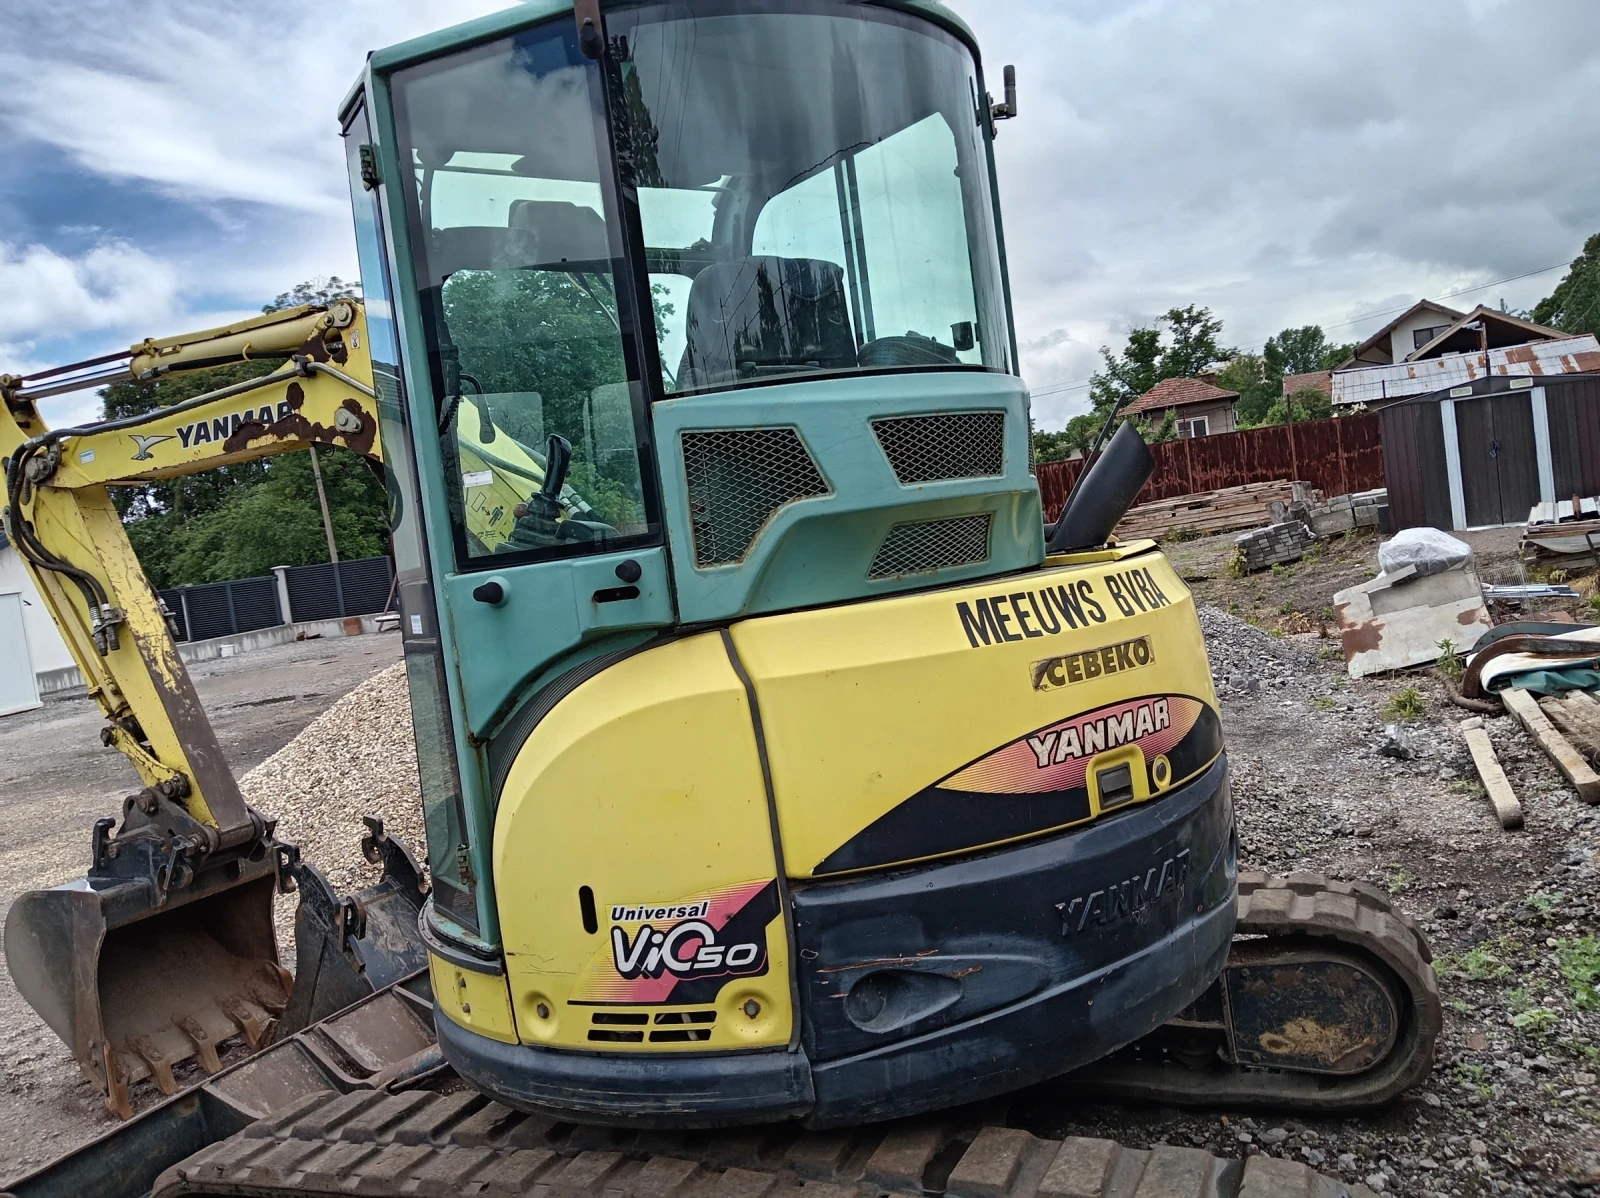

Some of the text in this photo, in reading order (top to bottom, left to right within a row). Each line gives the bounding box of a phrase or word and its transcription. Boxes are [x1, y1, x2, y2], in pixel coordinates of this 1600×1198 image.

[956, 567, 1172, 648] MEEUWS BVBA
[1046, 639, 1149, 686] CEBEKO
[1026, 698, 1170, 768] YANMAR
[611, 902, 708, 920] Universal
